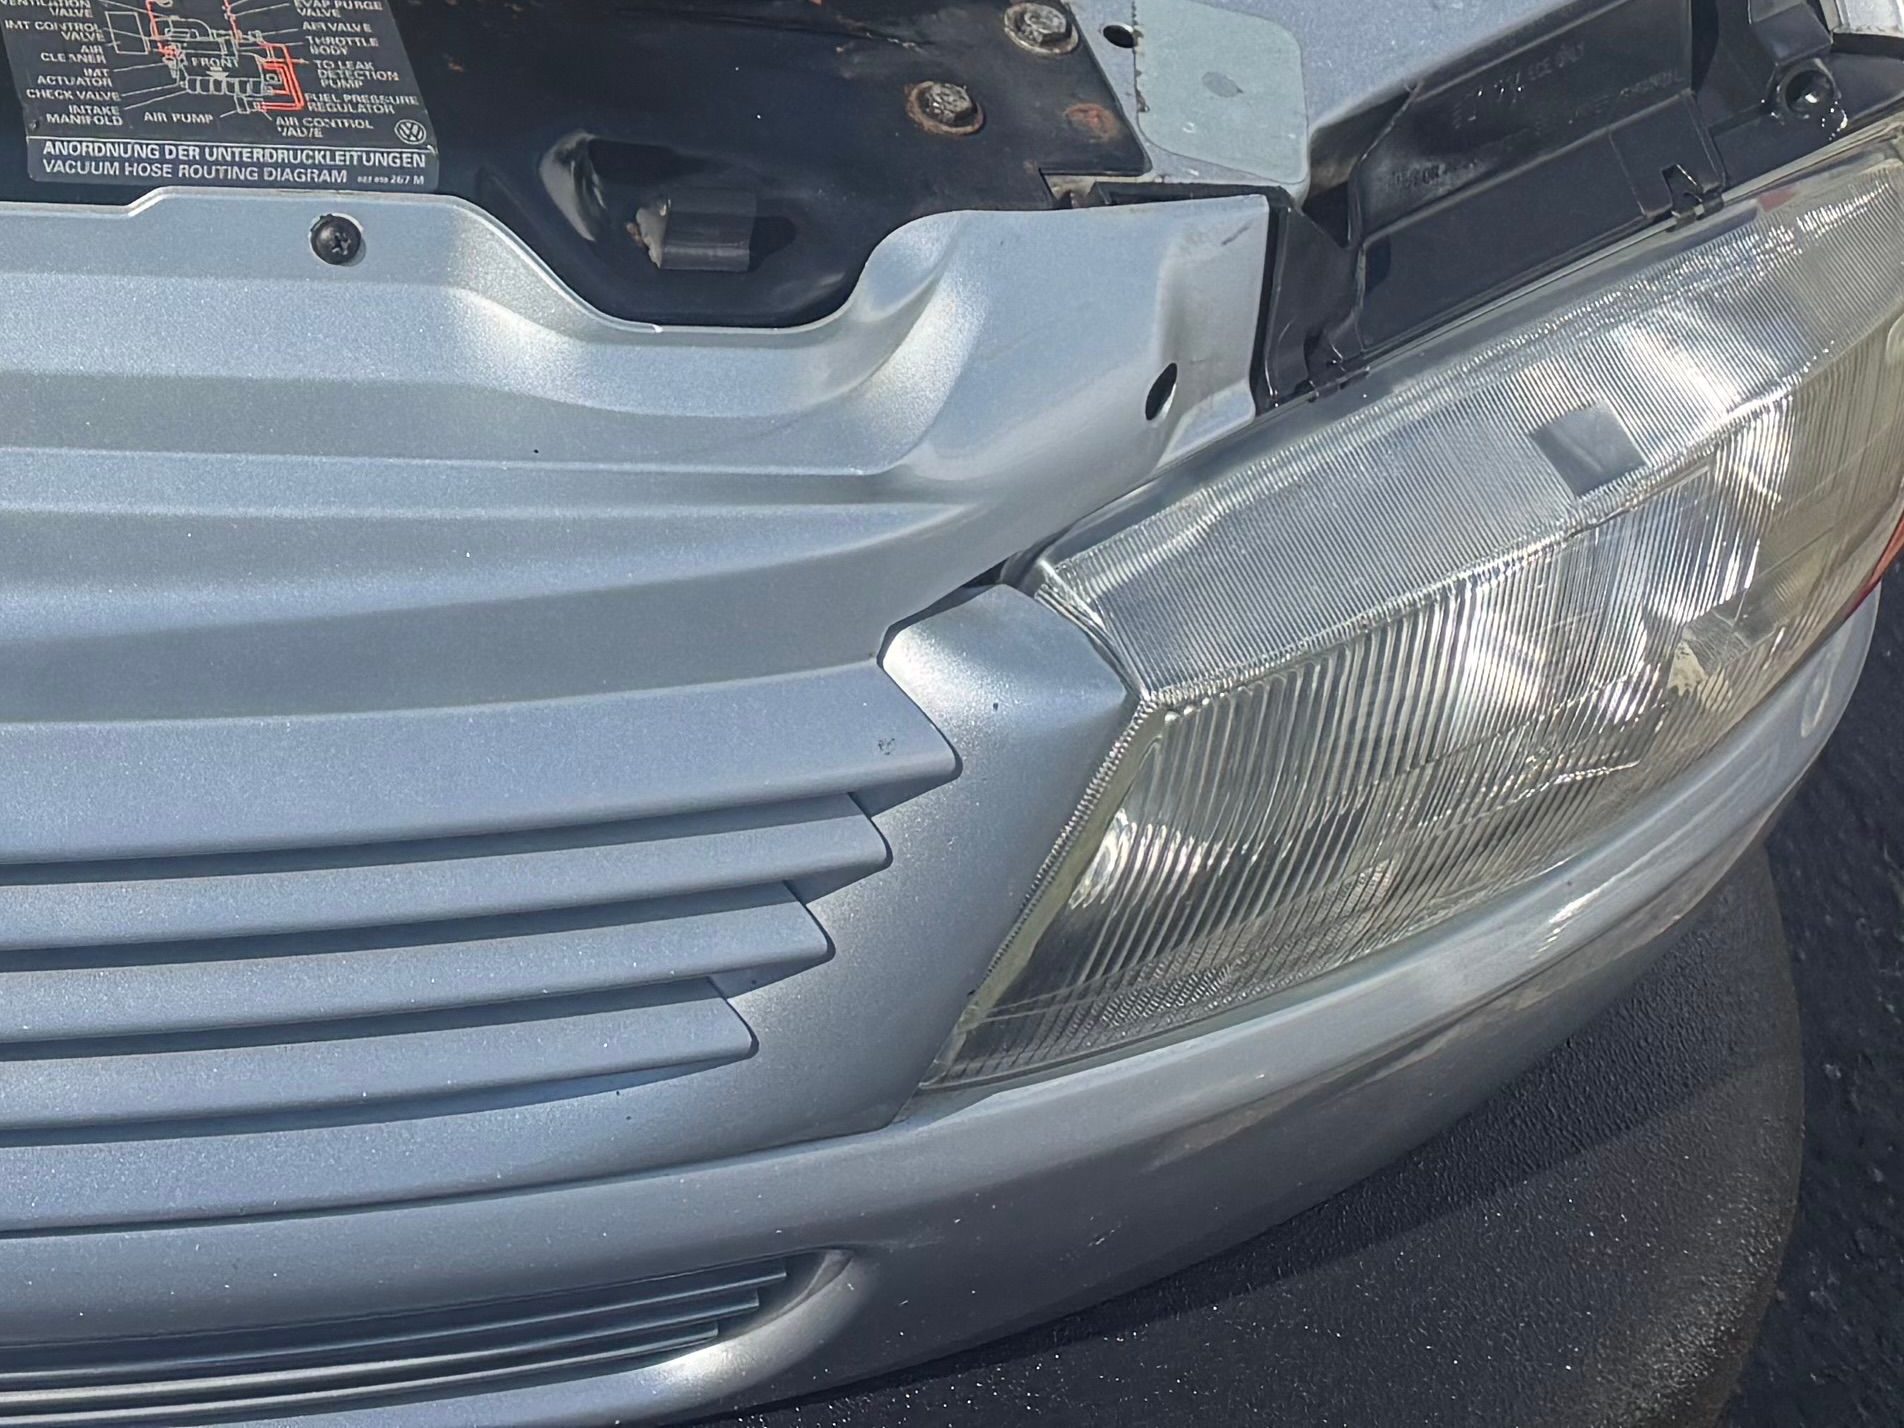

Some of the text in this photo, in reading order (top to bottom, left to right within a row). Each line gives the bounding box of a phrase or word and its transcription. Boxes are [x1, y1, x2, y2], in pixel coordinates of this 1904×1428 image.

[334, 0, 383, 11] PURGE
[60, 31, 106, 42] VALVE
[317, 59, 375, 71] TO LEAK
[318, 70, 400, 81] DETECTION
[321, 79, 365, 88] PUMP
[26, 89, 122, 101] CHECK VALVE
[68, 105, 120, 116] INTAKE
[46, 113, 123, 126] MANIFOLD
[143, 111, 214, 123] AIR PUMP
[43, 141, 425, 168] ANORDNUNG DER UNTERDRUCKLEITUNGEN
[42, 159, 120, 176] VACUUM
[124, 163, 172, 178] HOSE
[178, 164, 258, 181] ROUTING
[264, 167, 347, 184] DIAGRAM
[414, 176, 424, 185] M
